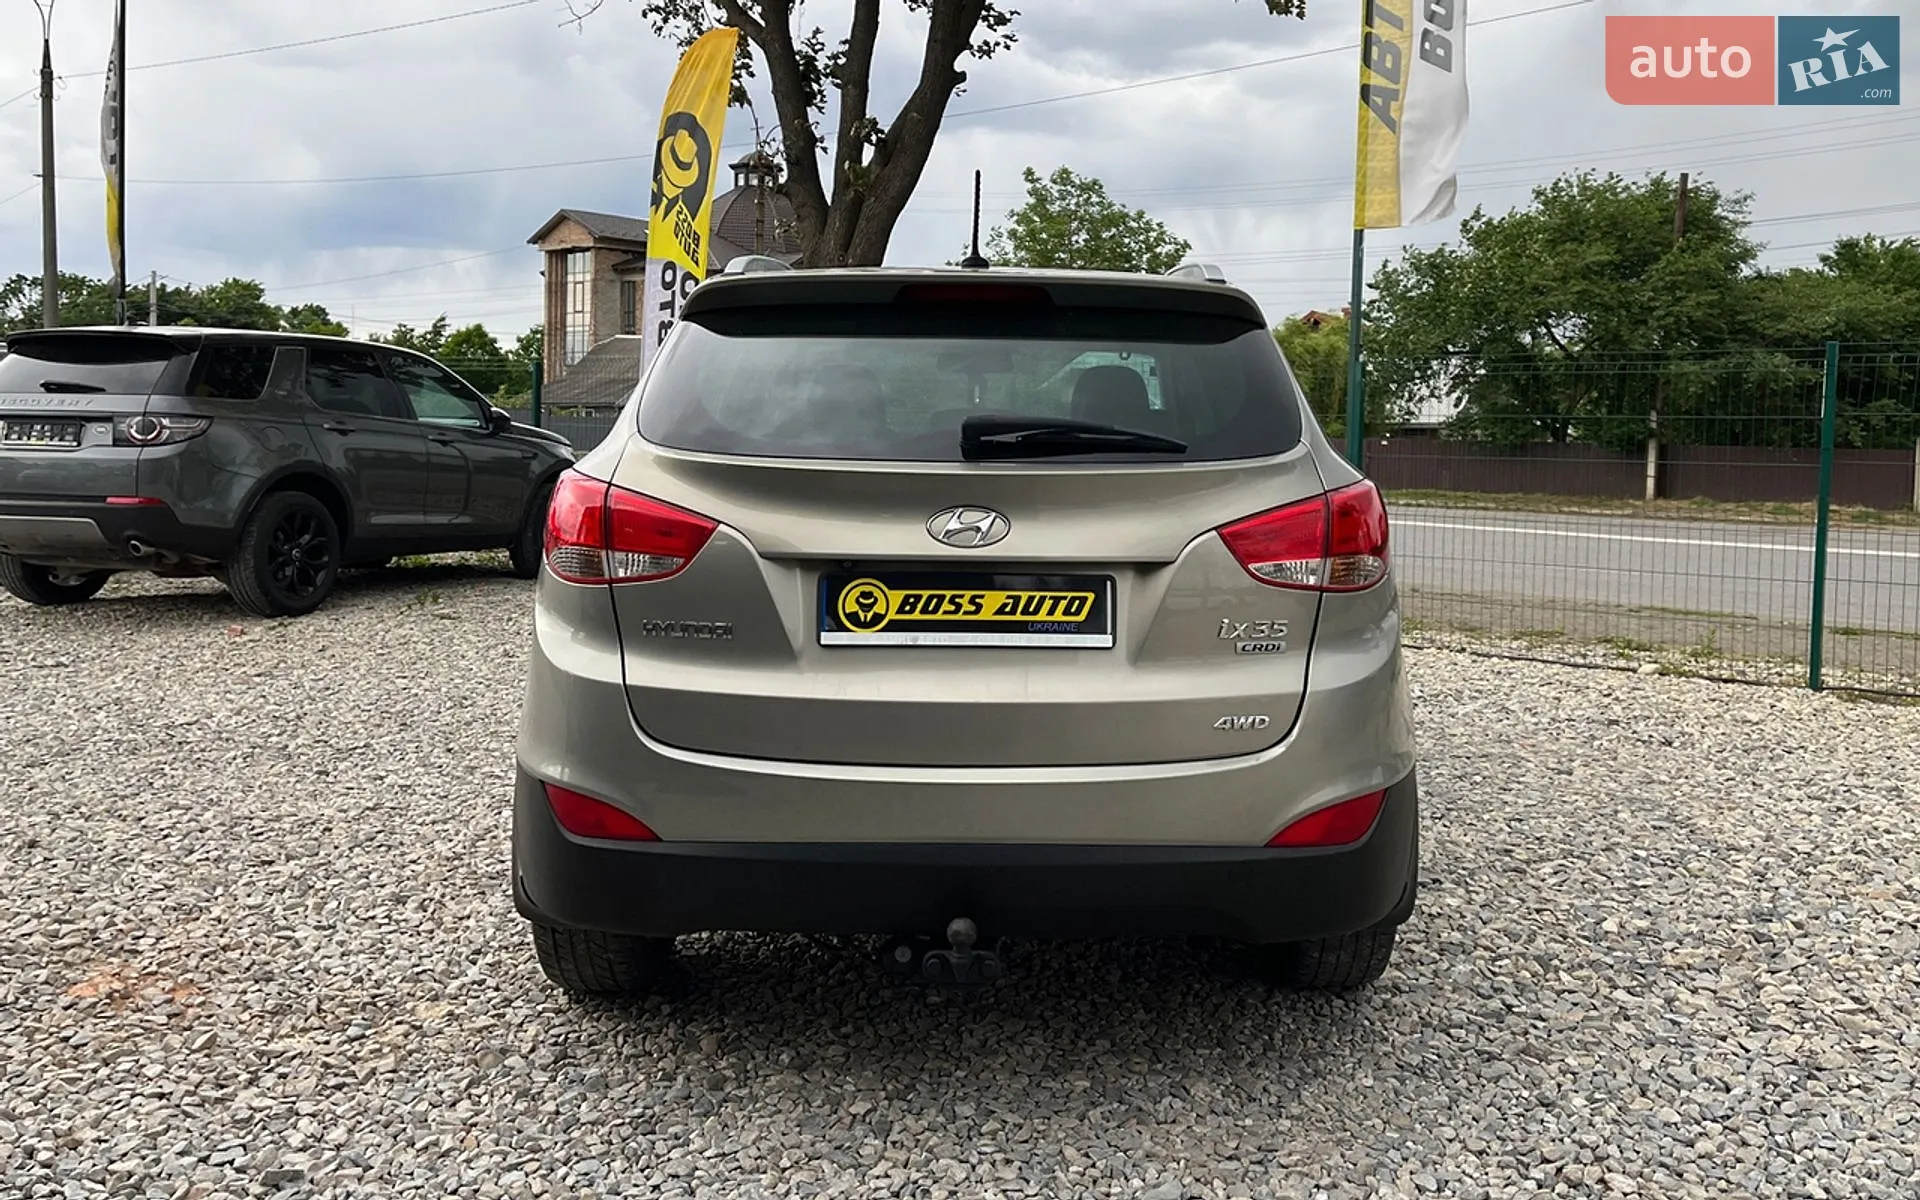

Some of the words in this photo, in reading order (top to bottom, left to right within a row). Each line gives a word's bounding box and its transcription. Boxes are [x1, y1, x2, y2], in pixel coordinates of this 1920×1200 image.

[895, 594, 986, 616] BOSS
[991, 594, 1083, 617] AUTO
[642, 619, 733, 639] HYUNDAI
[1027, 622, 1080, 633] UKRAINE
[1217, 618, 1289, 639] ix35
[1212, 715, 1271, 730] 4WD
